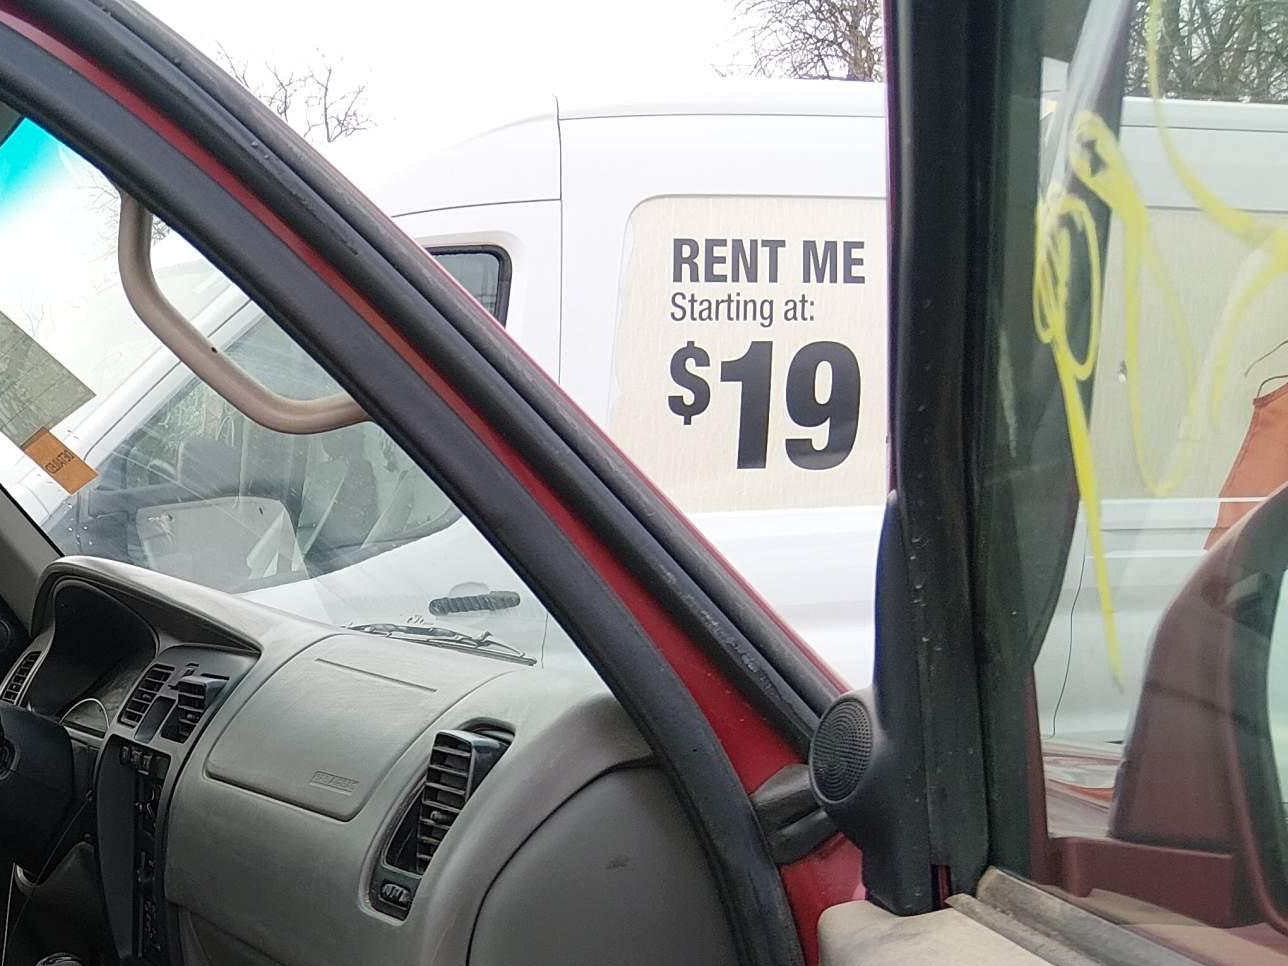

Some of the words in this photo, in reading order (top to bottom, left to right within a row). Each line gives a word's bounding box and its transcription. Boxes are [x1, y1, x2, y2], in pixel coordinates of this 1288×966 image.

[672, 238, 785, 283] RENT
[802, 240, 866, 284] ME
[670, 292, 774, 327] Starting
[783, 294, 816, 321] at:
[668, 340, 861, 470] $19
